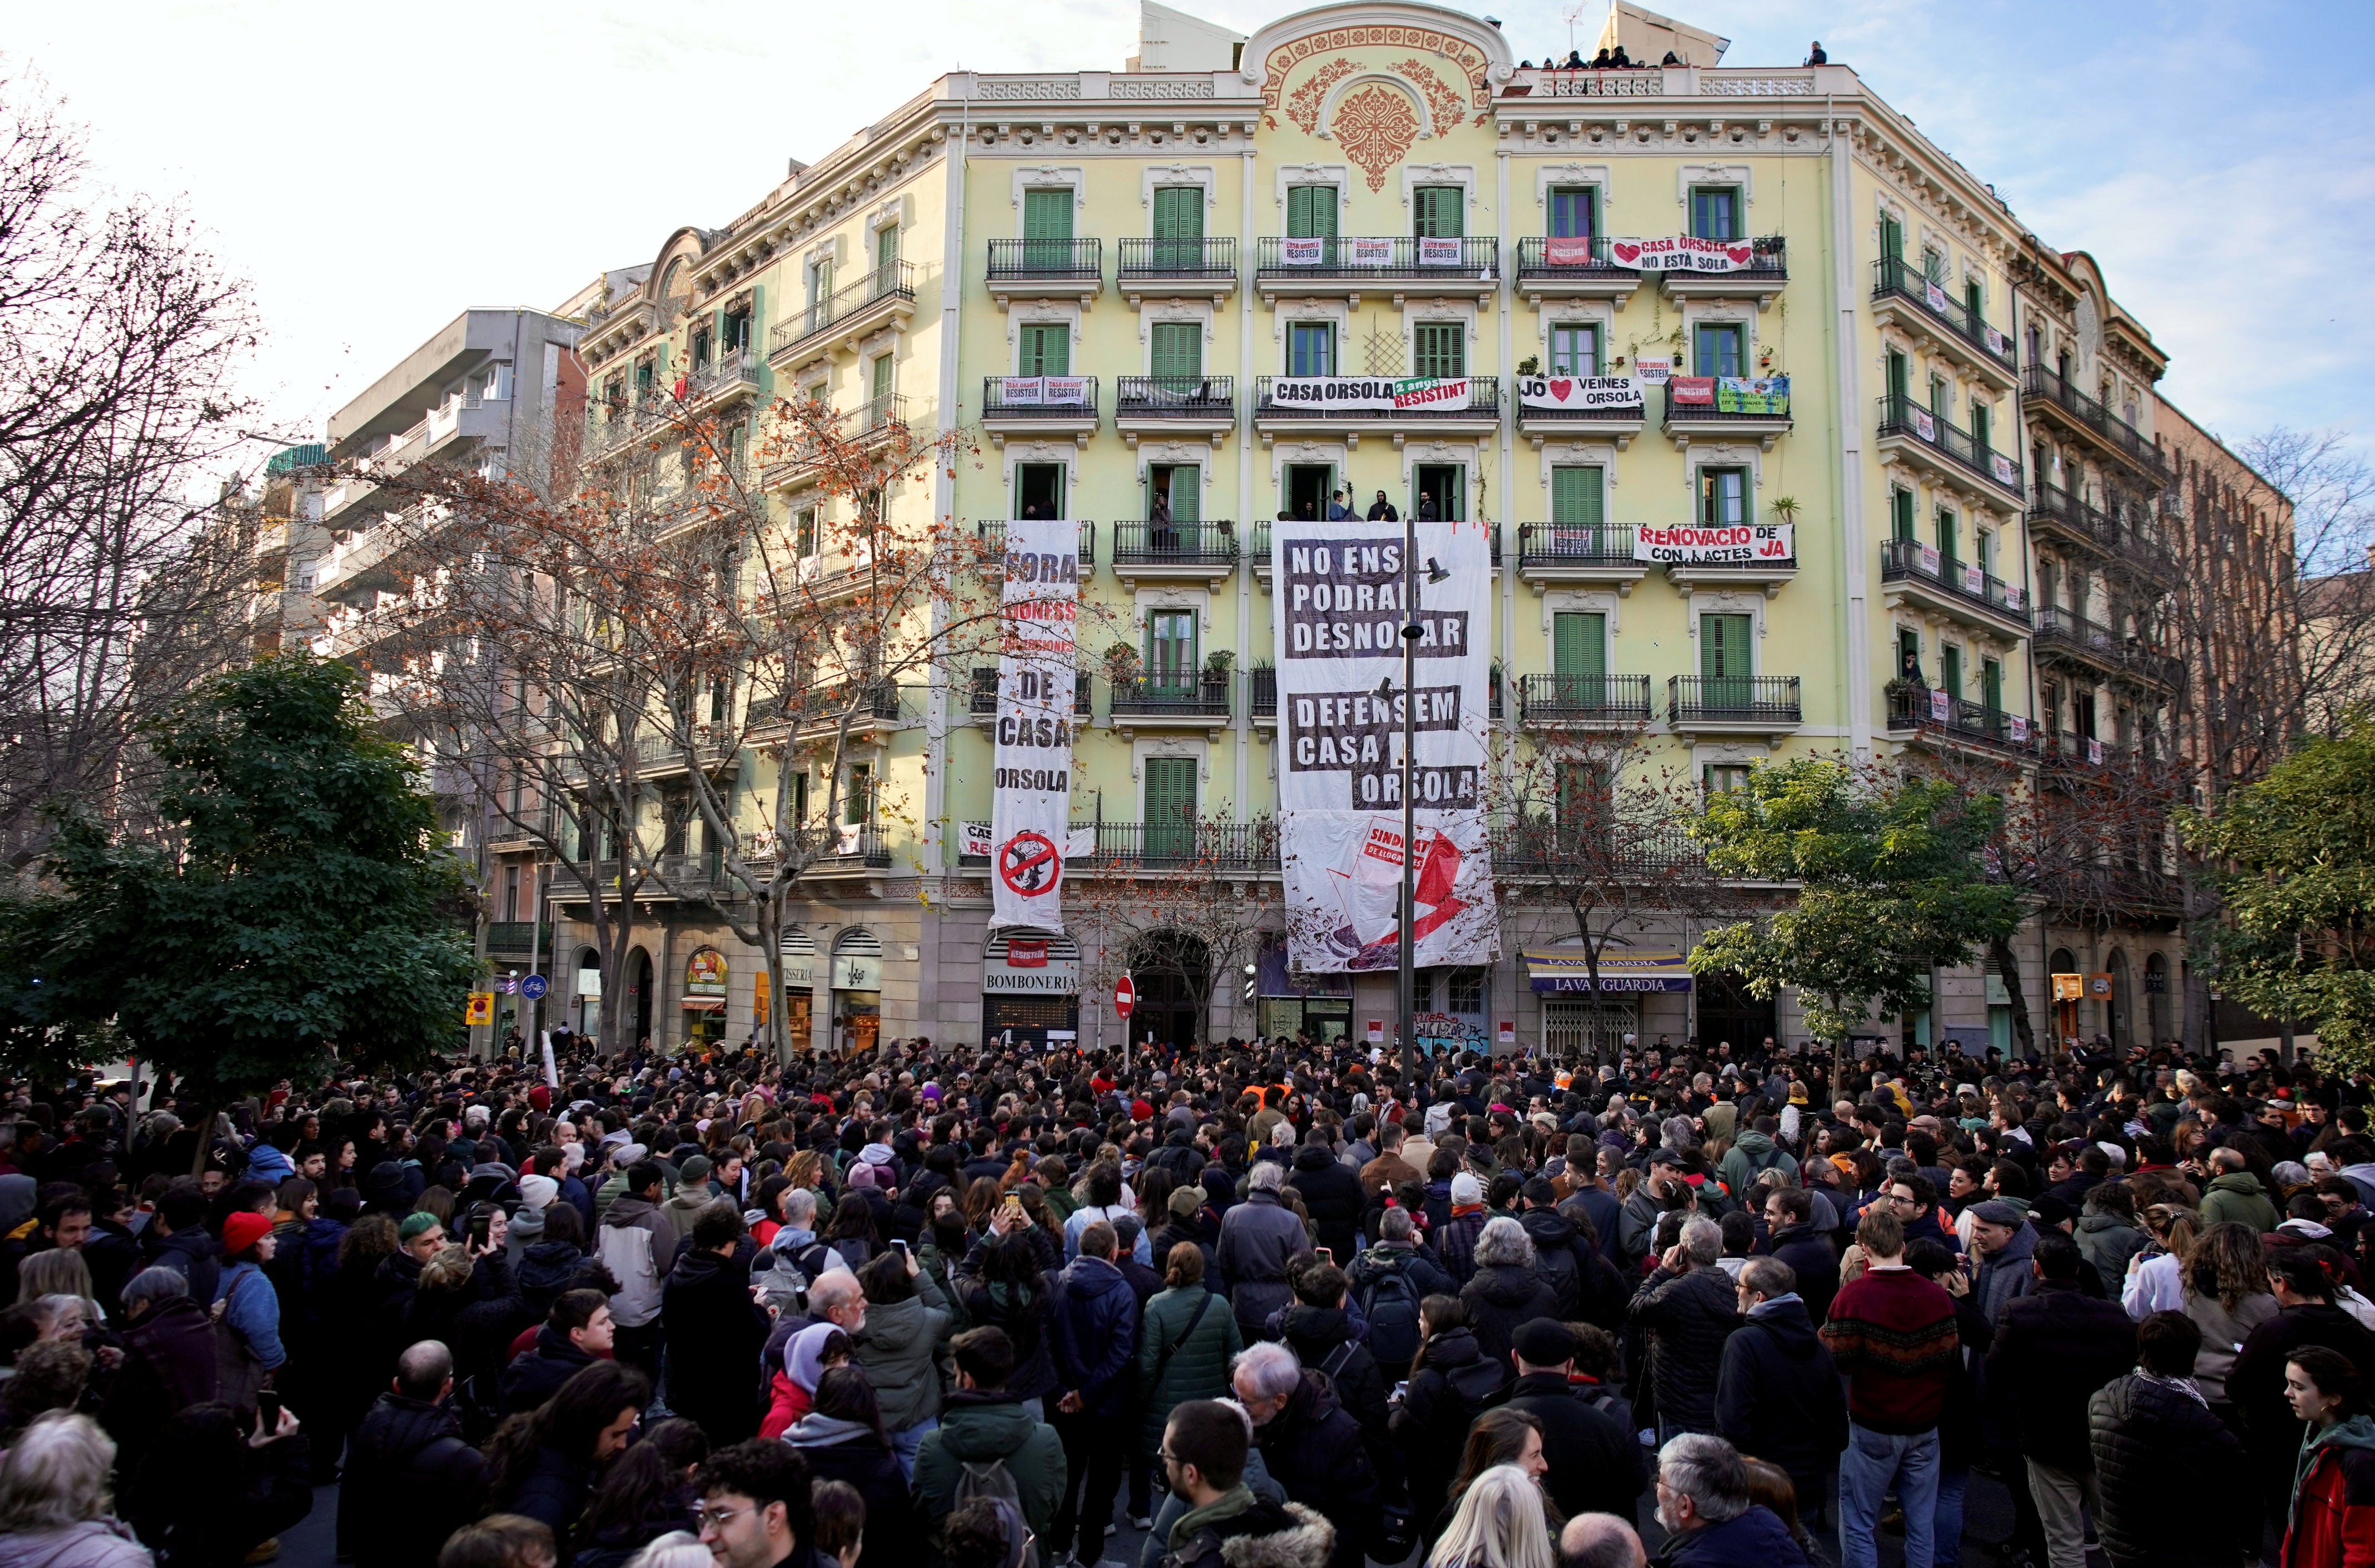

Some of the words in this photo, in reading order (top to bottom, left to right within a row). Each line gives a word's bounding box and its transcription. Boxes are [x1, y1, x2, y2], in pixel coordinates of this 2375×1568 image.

[1642, 240, 1675, 252] CASA
[1680, 236, 1728, 252] ORSOLA
[1287, 249, 1319, 258] RESISTEIX
[1356, 249, 1389, 258] RESISTEIX
[1424, 249, 1457, 258] RESISTEIX
[1551, 248, 1584, 257] RESISTEIX
[1642, 256, 1658, 268] NO
[1665, 253, 1693, 267] ESTÀ
[1698, 257, 1728, 270] SOLA
[1641, 369, 1668, 378] ESISTEIX
[1006, 388, 1038, 397] RESISTEIX
[1049, 388, 1081, 397] RESISTEIX
[1277, 383, 1323, 401] CASA
[1325, 382, 1395, 399] ORSOLA
[1396, 383, 1404, 392] 2
[1407, 379, 1439, 391] anys
[1521, 381, 1546, 397] JO
[1675, 387, 1710, 396] RESISTEIX
[1394, 381, 1466, 409] RESISTINT
[1587, 390, 1642, 404] ORSOLA
[1756, 527, 1777, 539] DE
[1554, 537, 1588, 549] RESISTEIX
[1760, 540, 1786, 556] JA
[1291, 546, 1331, 575] NO
[1344, 545, 1400, 575] ENS
[1020, 671, 1054, 700] DE
[1296, 691, 1455, 728] DEFENSEM
[998, 716, 1070, 748] CASA
[1296, 735, 1380, 765] CASA
[995, 768, 1067, 792] ORSOLA
[1370, 828, 1430, 853] SINDIAT
[1368, 846, 1378, 854] DE
[1011, 950, 1045, 959] RESISTEIX
[987, 975, 1076, 989] BOMBONERIA
[1555, 979, 1573, 990] LA
[1574, 979, 1666, 991] VAGUARDIA
